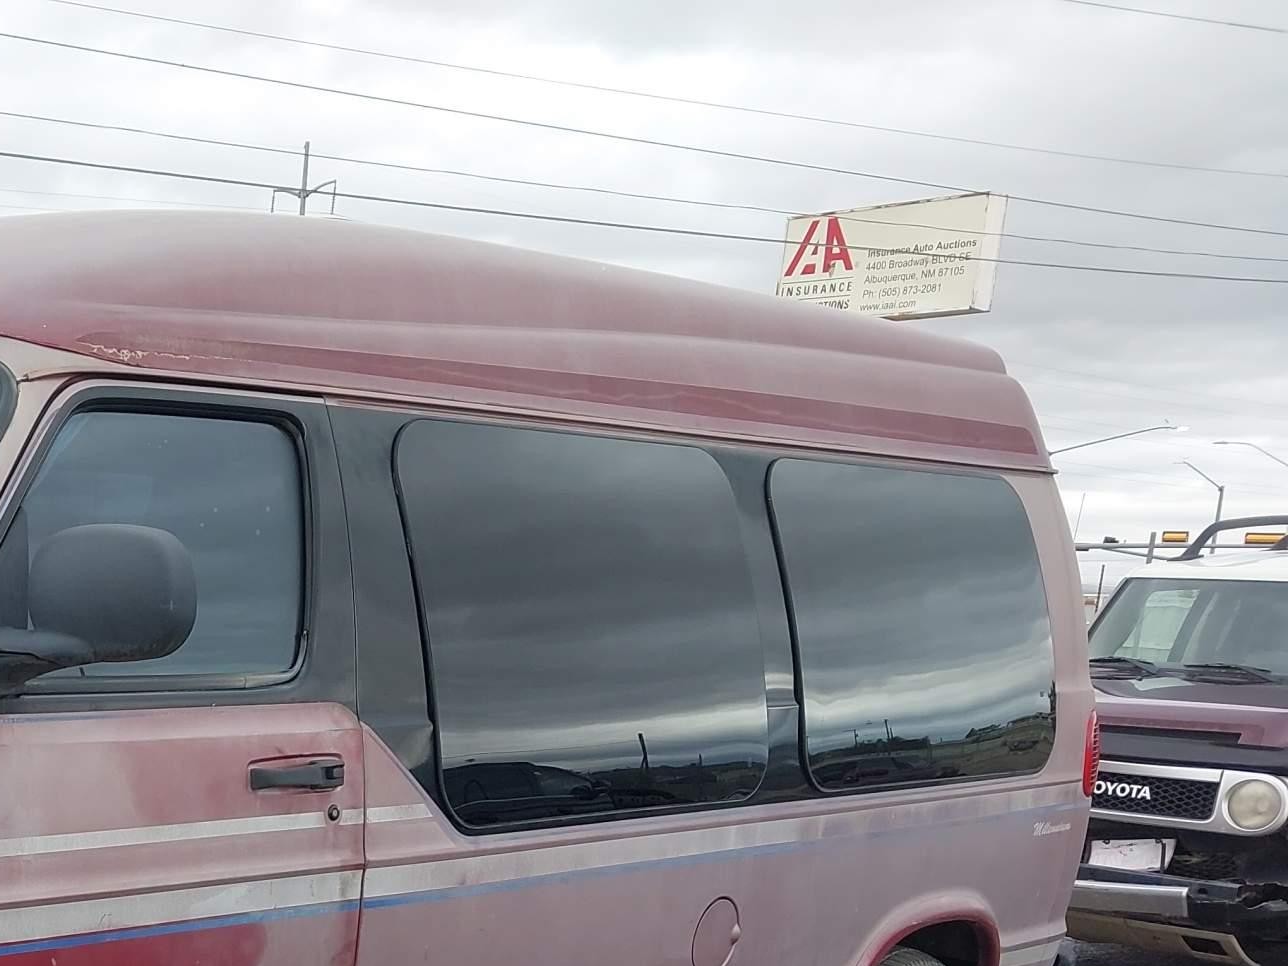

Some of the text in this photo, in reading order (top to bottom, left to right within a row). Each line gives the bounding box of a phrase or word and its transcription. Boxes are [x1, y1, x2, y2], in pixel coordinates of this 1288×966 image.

[867, 239, 978, 258] Insurance Auto Auctions
[866, 259, 887, 270] 4400
[888, 257, 929, 269] Broadway
[863, 265, 965, 285] Albuquerque, NM 87105
[781, 281, 853, 297] INSURANCE
[878, 286, 901, 299] (505)
[902, 283, 942, 296] 873-2081
[1094, 780, 1151, 800] OYOTA
